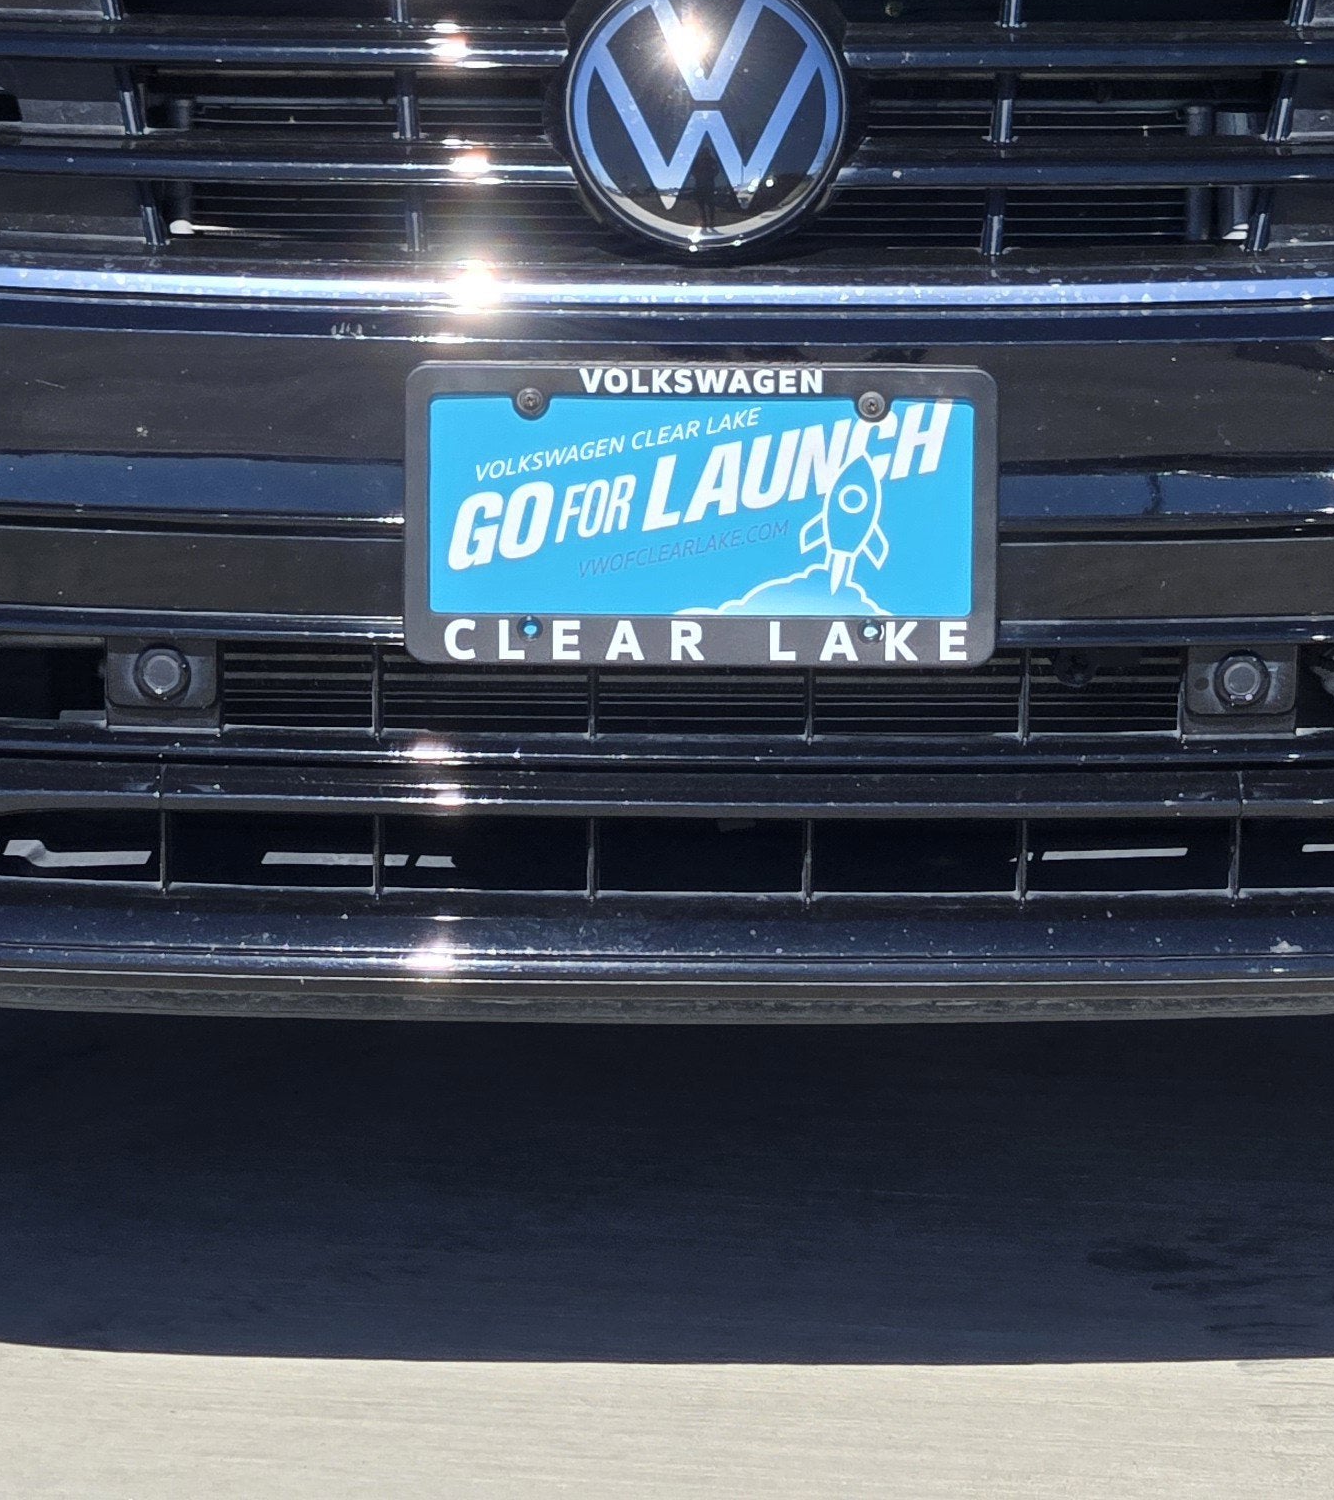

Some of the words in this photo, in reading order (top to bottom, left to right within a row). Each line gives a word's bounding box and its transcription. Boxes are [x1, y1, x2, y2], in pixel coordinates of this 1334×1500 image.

[579, 367, 823, 394] VOLKSWAGEN
[474, 434, 625, 482] VOLKSWAGEN
[631, 419, 701, 451] CLEAR
[705, 406, 762, 436] LAKE
[447, 479, 552, 571] GO
[554, 474, 635, 543] FOR
[641, 399, 953, 533] LAUNCH
[576, 518, 790, 579] VWOFCLEARLAKE.COM
[443, 618, 705, 662] CLEAR
[769, 619, 967, 663] LAKE
